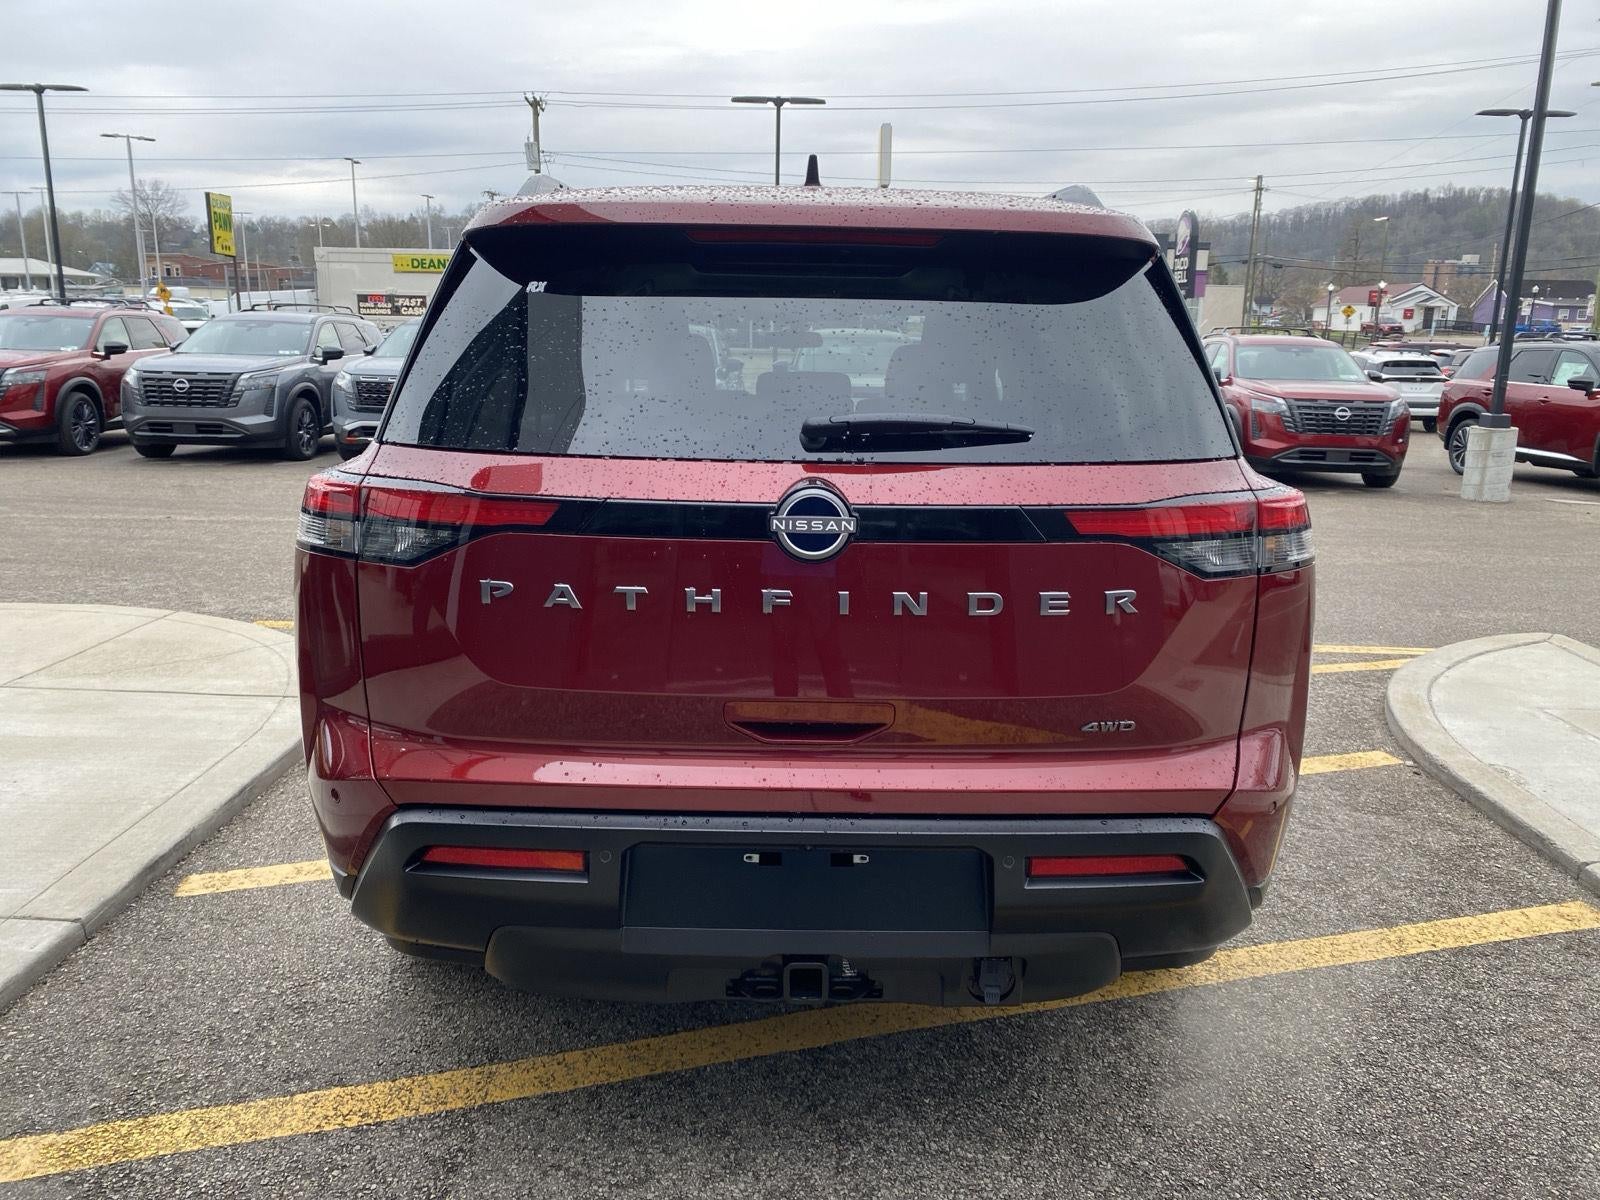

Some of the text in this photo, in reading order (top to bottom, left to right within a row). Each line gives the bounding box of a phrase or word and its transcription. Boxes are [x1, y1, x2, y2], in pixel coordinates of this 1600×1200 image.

[213, 211, 233, 233] PAWN
[1174, 257, 1189, 271] TACO
[1174, 271, 1188, 284] BELL
[399, 298, 423, 307] FAST
[401, 307, 426, 315] CASH
[772, 519, 854, 531] NISSAN
[479, 578, 1139, 617] PATHFINDER
[1081, 720, 1136, 732] 4WD
